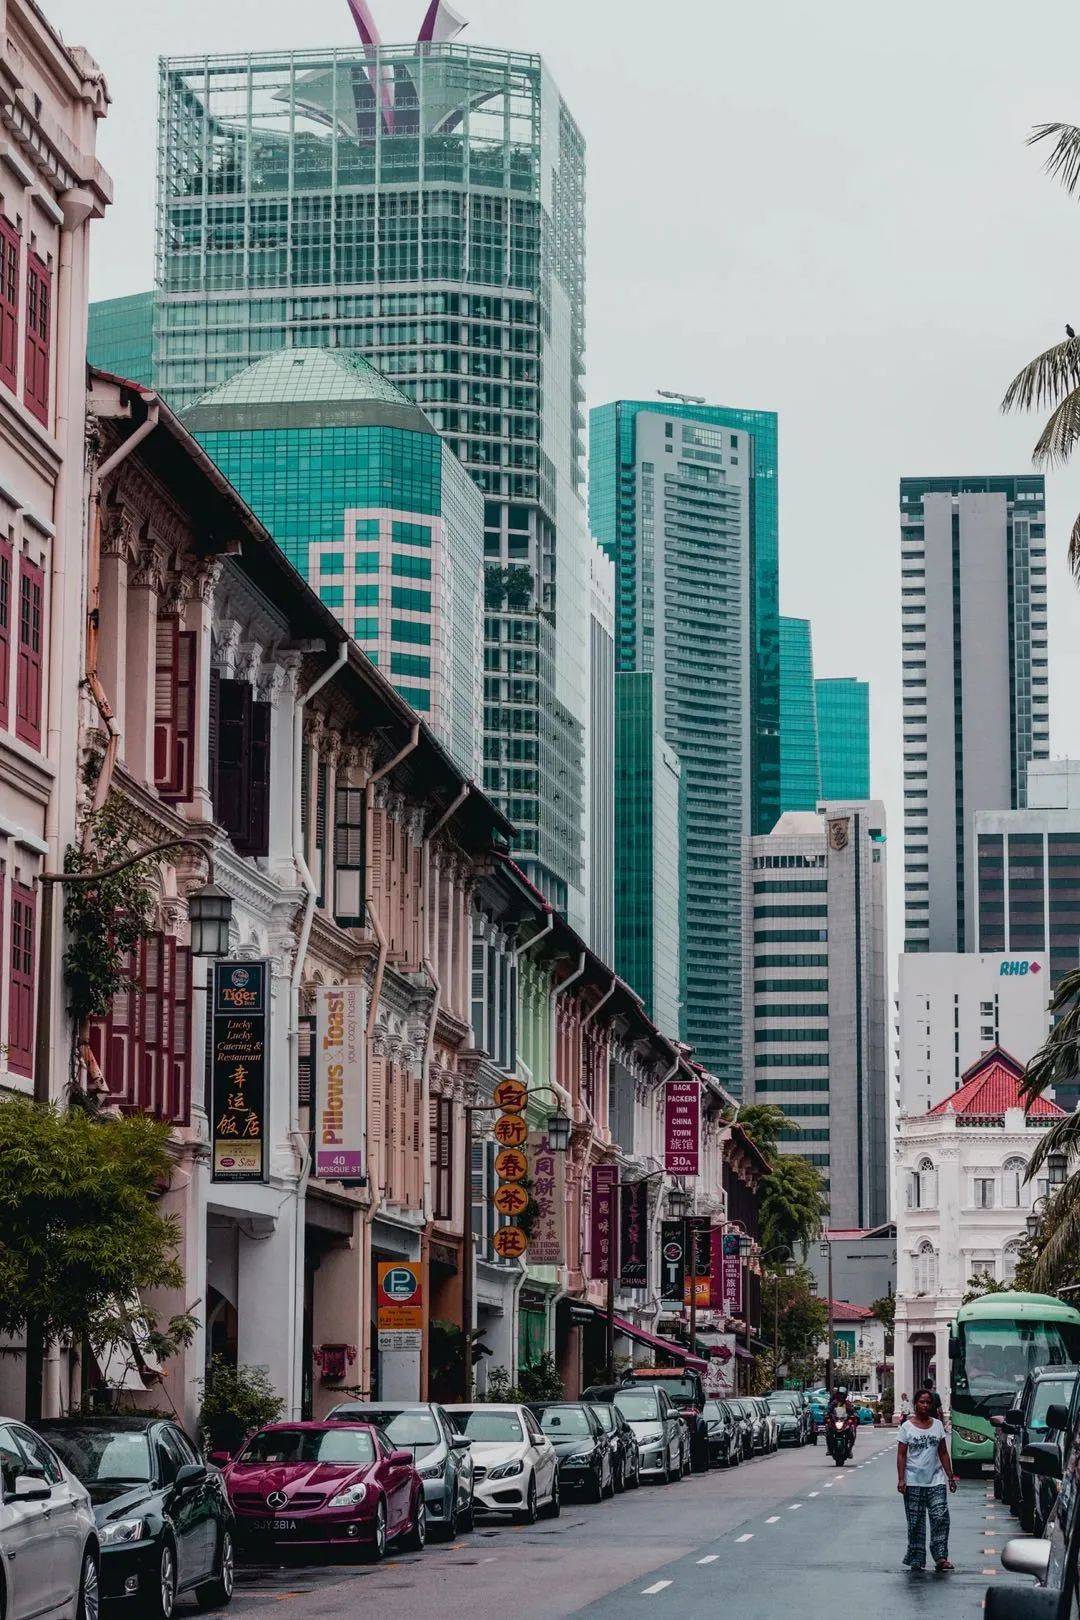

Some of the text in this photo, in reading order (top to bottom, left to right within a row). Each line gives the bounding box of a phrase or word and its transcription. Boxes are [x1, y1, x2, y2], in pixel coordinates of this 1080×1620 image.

[1000, 961, 1029, 975] RHB
[223, 988, 257, 1006] Tiger
[227, 1020, 252, 1030] Lucky
[323, 991, 344, 1049] Toast
[346, 991, 356, 1064] your cozy hostel
[227, 1031, 252, 1041] Lucky
[217, 1041, 262, 1052] Catering &
[217, 1053, 262, 1061] Restaurant
[322, 1064, 343, 1144] Pillows
[333, 1156, 346, 1165] 40
[672, 1157, 691, 1166] 30A
[391, 1271, 410, 1292] P
[684, 1284, 707, 1297] SOL
